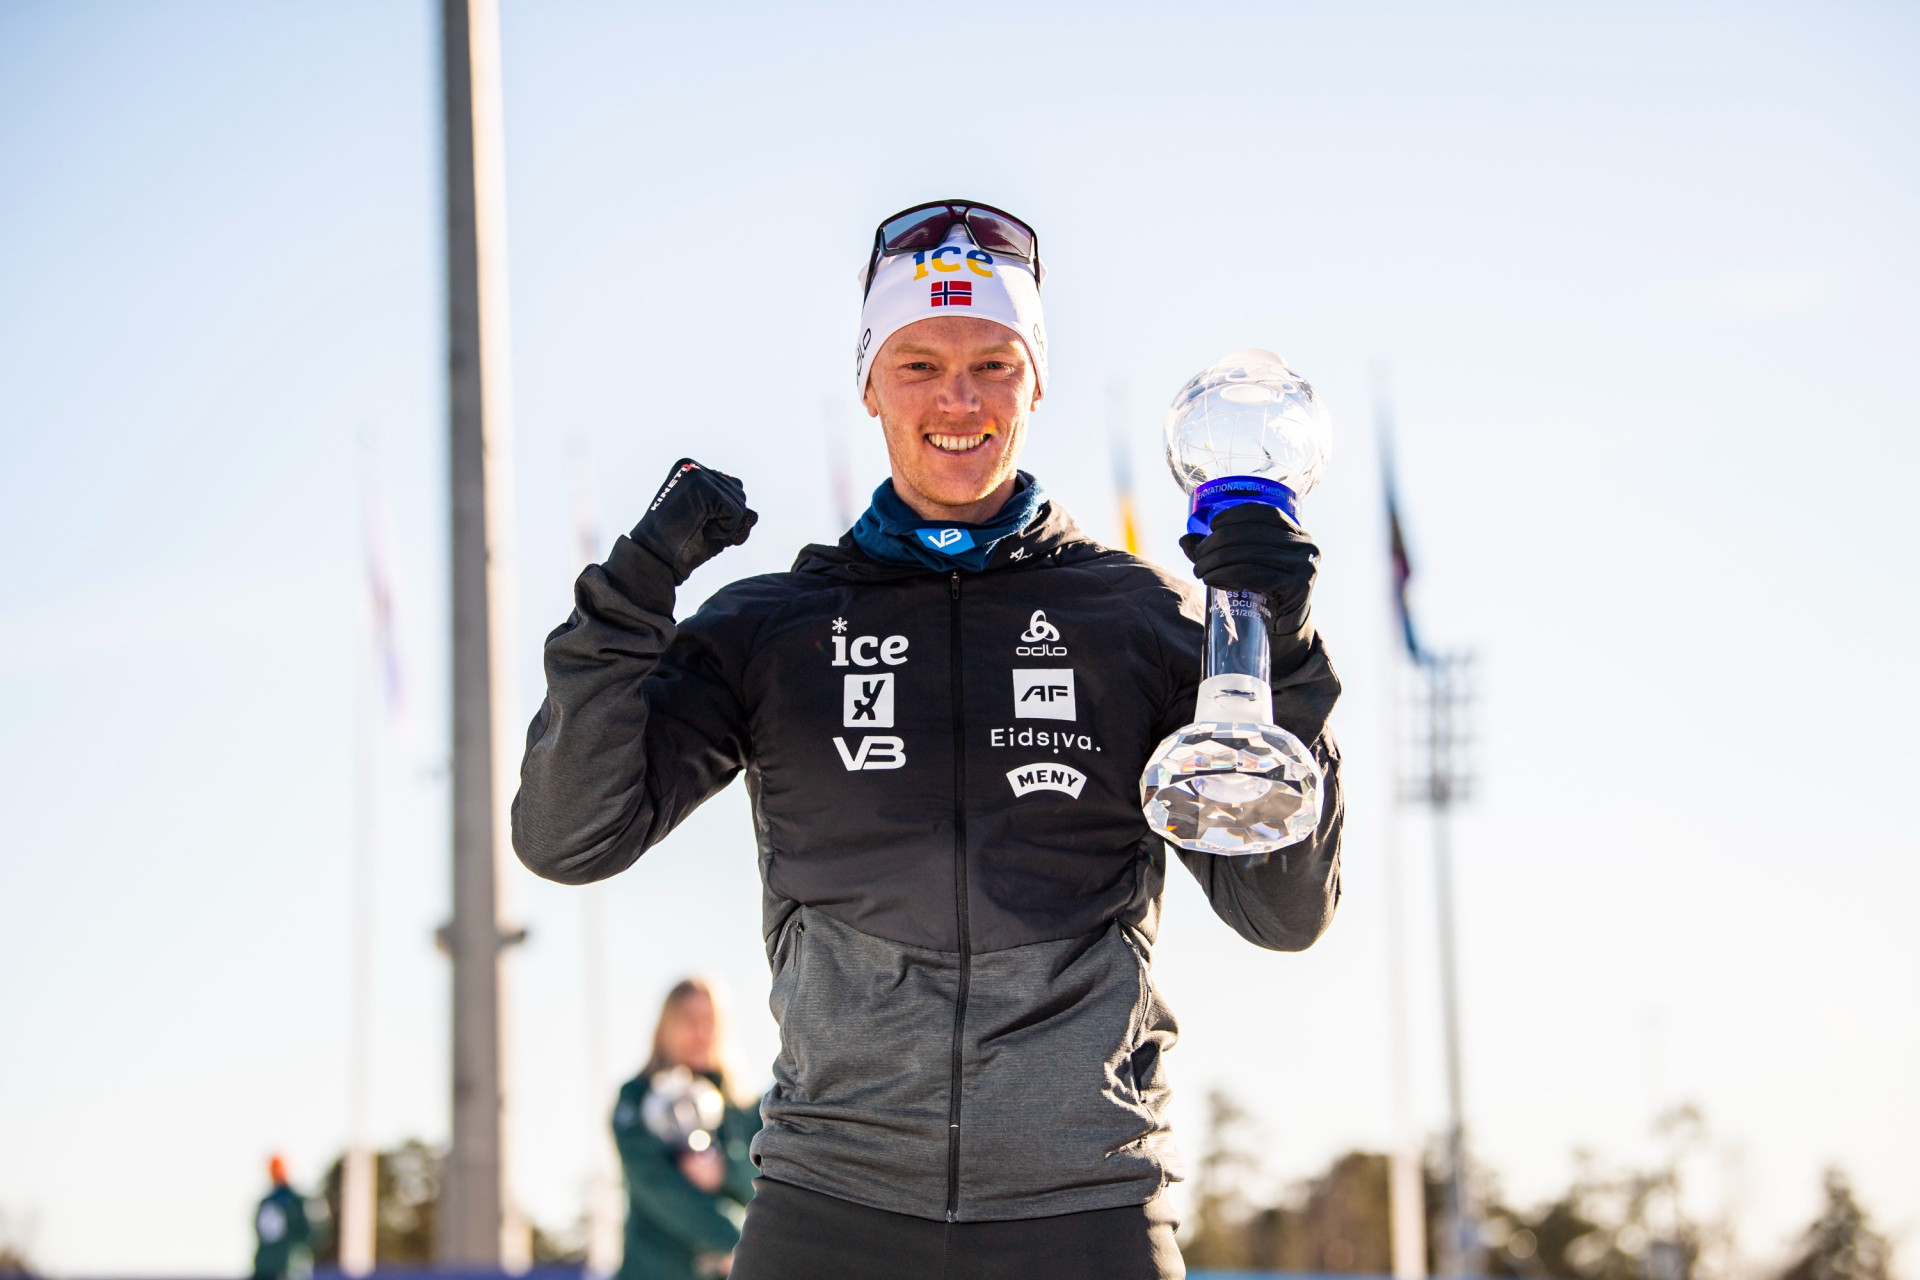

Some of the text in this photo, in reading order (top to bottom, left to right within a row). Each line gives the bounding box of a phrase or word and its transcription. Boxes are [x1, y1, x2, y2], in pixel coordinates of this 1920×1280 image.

[912, 246, 994, 281] ice
[927, 528, 963, 549] VB
[1219, 608, 1262, 619] 221/2022
[831, 616, 910, 667] ice
[1015, 643, 1067, 657] odlo
[1020, 685, 1069, 702] AF
[832, 735, 907, 772] VB
[1016, 769, 1079, 788] MENY
